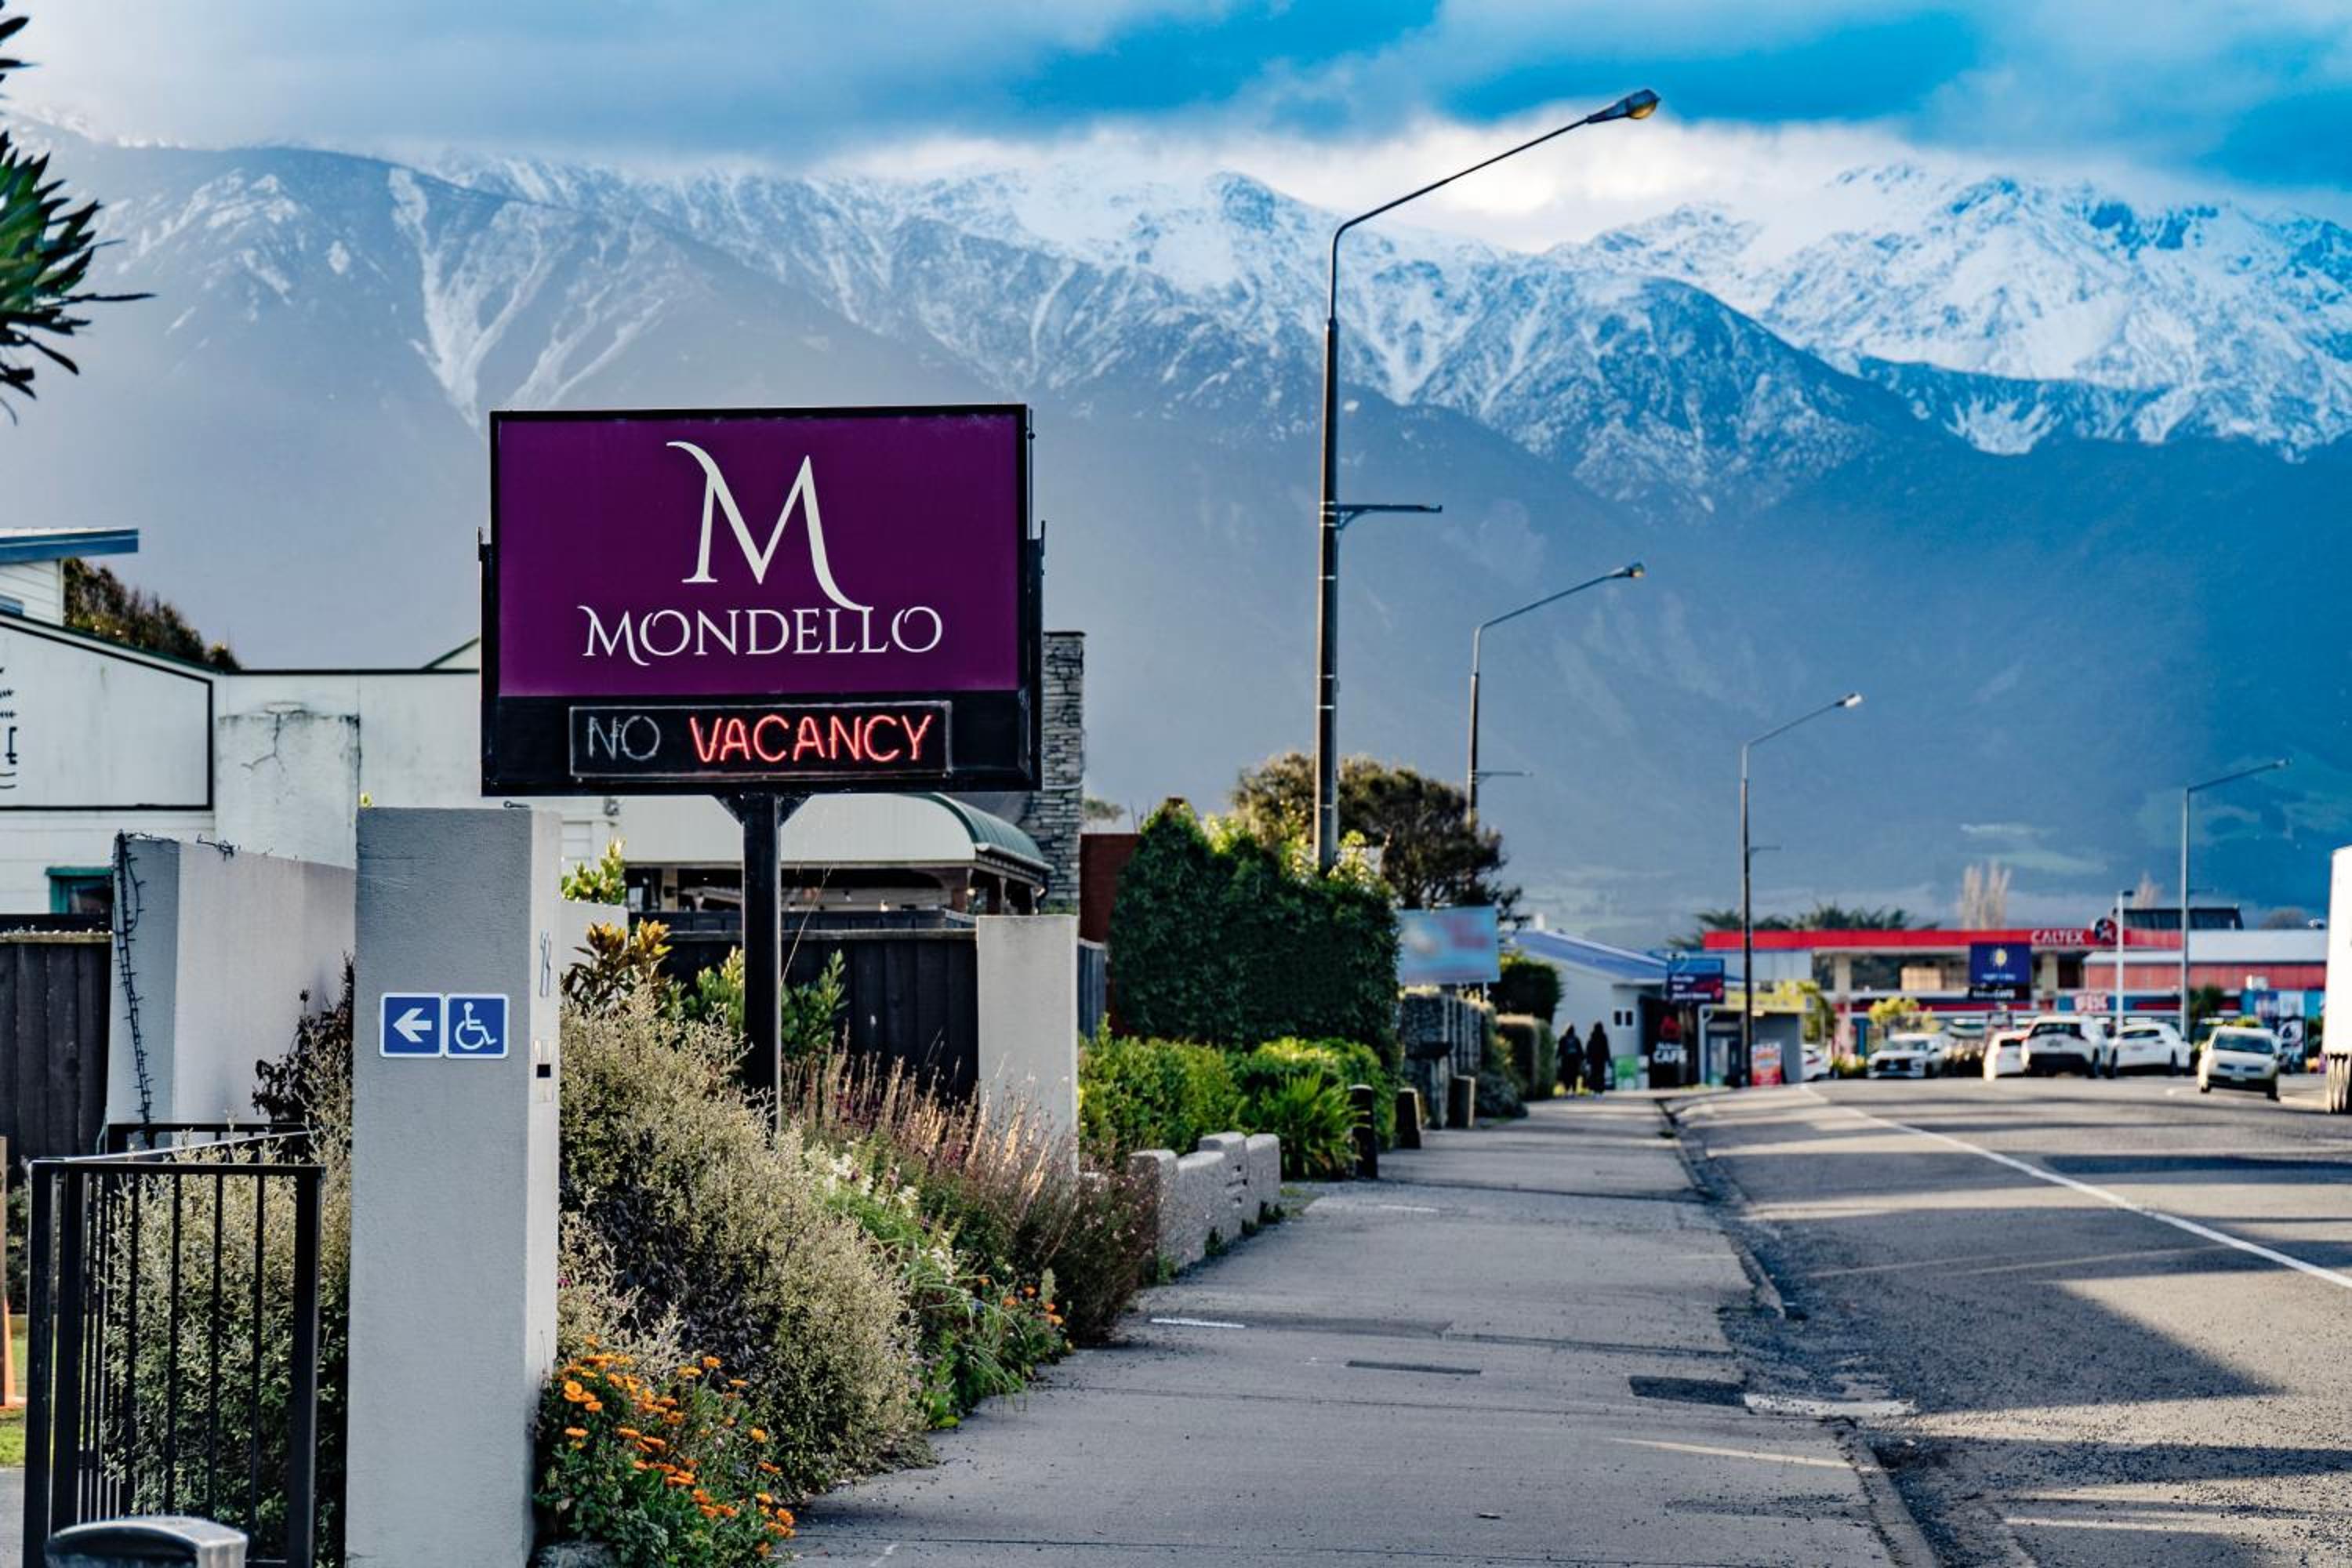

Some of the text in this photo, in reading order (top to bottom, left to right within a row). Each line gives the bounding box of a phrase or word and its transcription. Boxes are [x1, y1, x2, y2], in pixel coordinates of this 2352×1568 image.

[666, 441, 874, 611] M
[577, 605, 943, 666] MONDELLO
[587, 714, 933, 763] NO VACANCY
[2031, 930, 2085, 945] CALTEX
